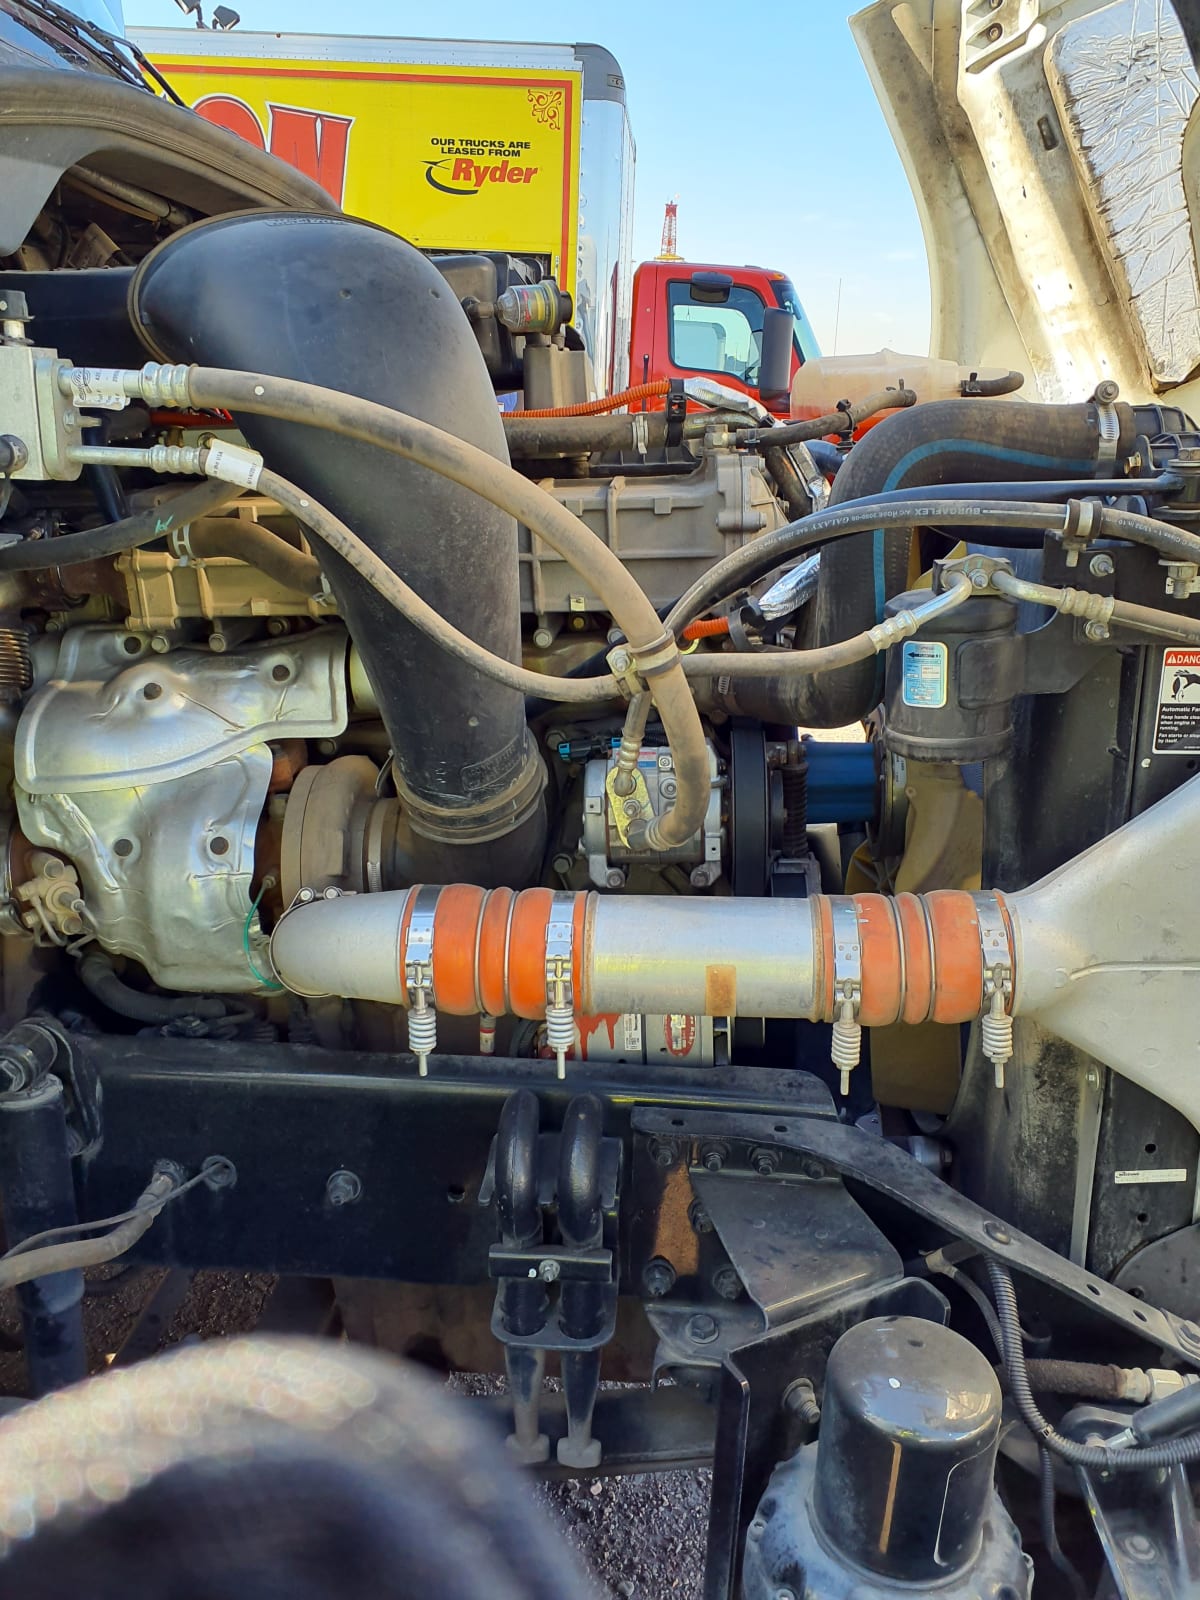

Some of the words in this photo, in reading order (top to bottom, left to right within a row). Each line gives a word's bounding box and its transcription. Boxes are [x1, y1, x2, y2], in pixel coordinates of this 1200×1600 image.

[431, 137, 455, 146] OUR
[458, 139, 505, 149] TRUCKS
[508, 141, 531, 149] ARE
[441, 147, 485, 156] LEASED
[488, 148, 521, 157] FROM
[451, 157, 538, 188] Ryder
[914, 507, 981, 516] BURGAFLEX
[811, 516, 850, 531] GALAXY
